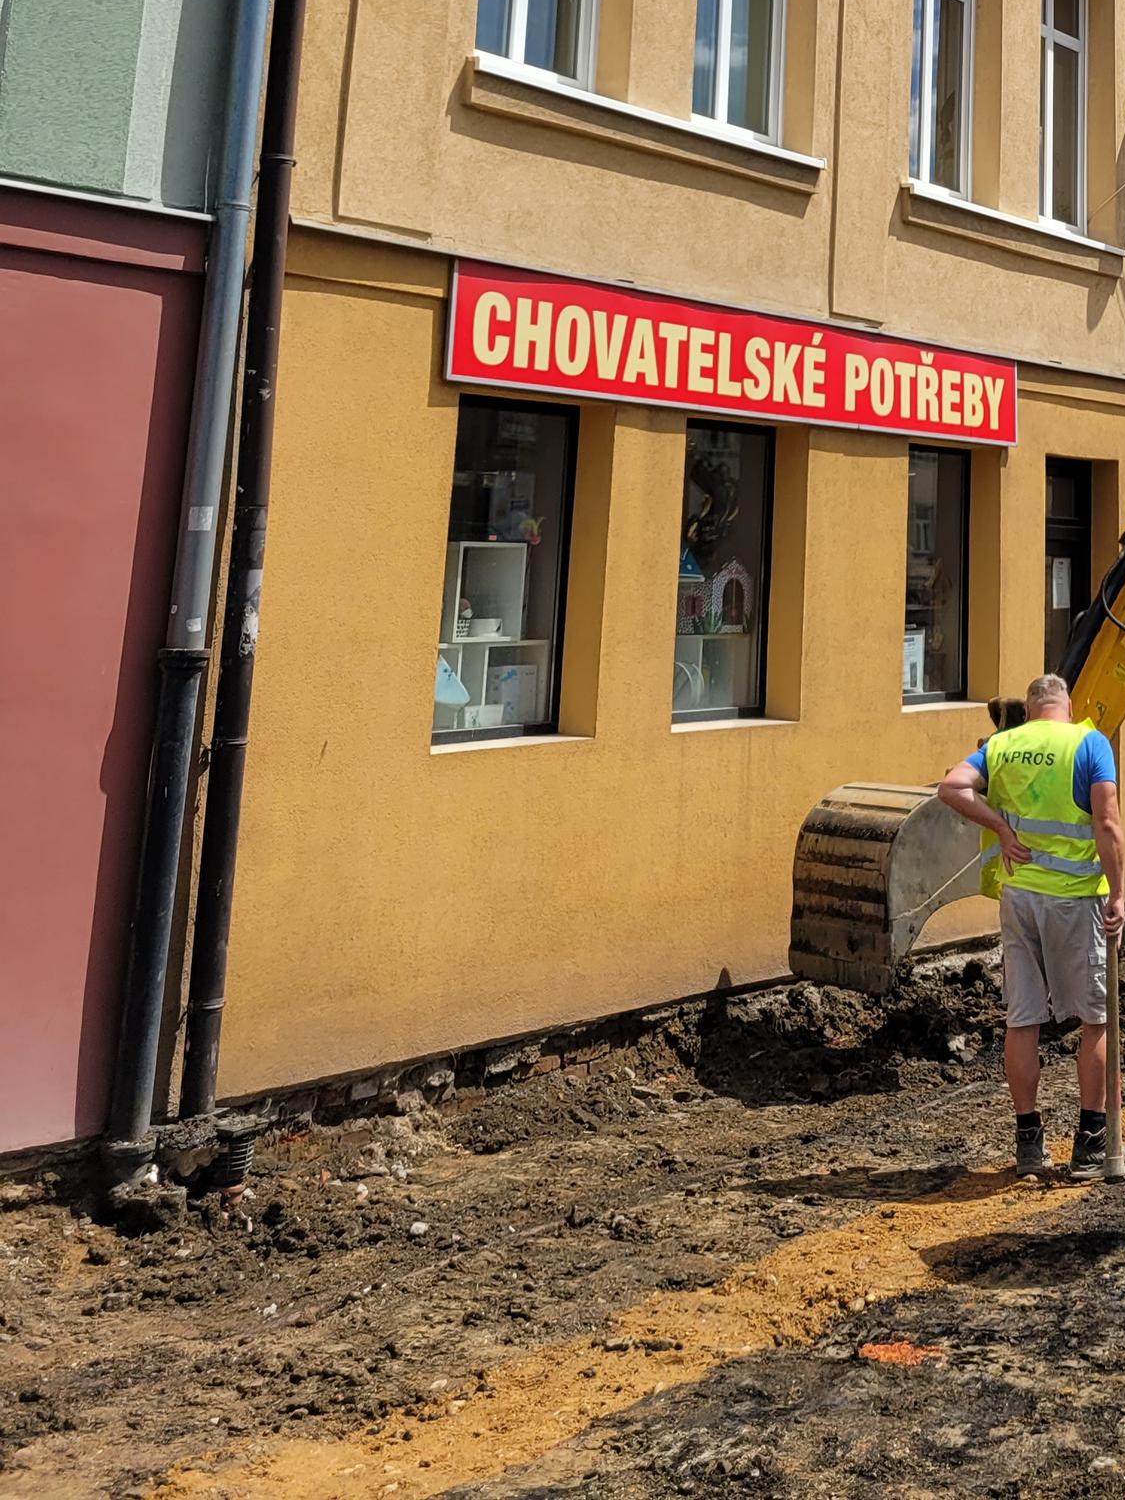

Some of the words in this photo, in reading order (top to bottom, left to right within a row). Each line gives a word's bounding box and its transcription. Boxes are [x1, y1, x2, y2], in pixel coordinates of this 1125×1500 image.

[472, 291, 827, 407] CHOVATELSKÉ
[844, 352, 1004, 431] POTŘEBY
[996, 750, 1055, 766] INPROS
